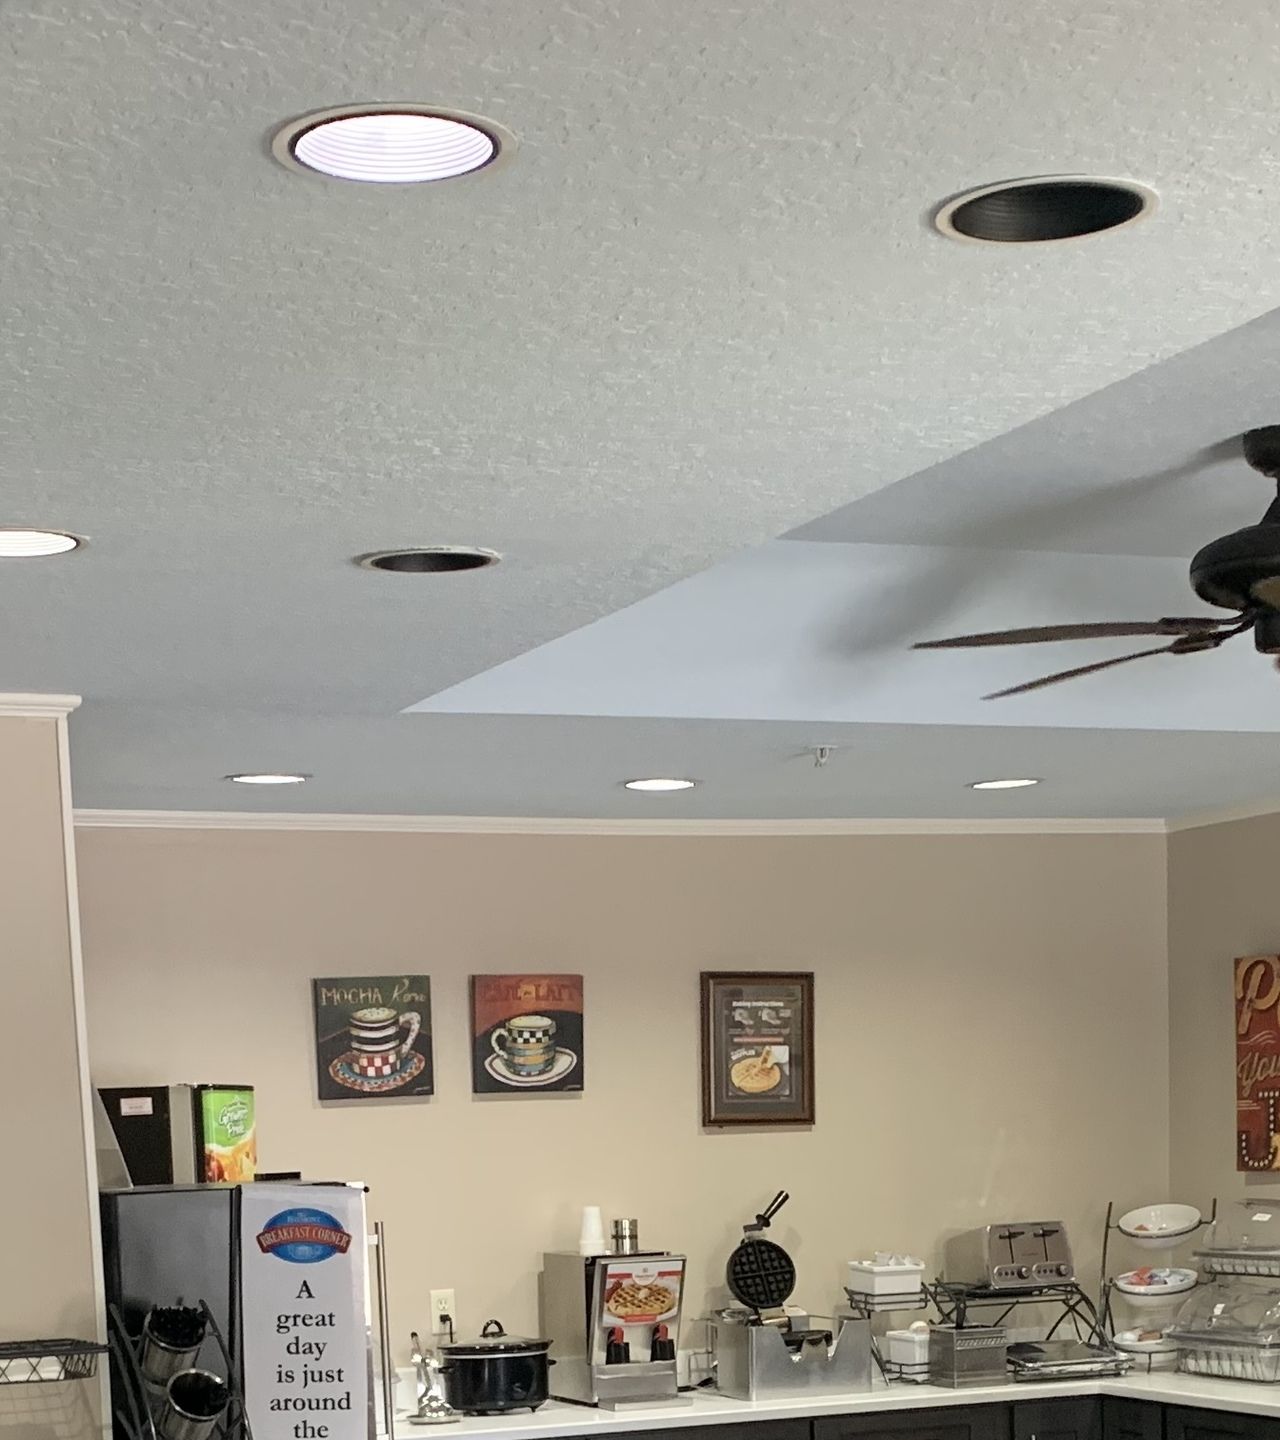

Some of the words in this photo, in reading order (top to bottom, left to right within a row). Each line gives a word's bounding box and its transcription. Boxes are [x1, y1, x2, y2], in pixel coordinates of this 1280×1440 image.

[320, 987, 382, 1006] MOCHA
[260, 1226, 310, 1248] BREAKFAST
[312, 1226, 350, 1247] CORNER
[295, 1279, 316, 1299] A
[276, 1311, 336, 1335] great
[286, 1335, 328, 1361] day
[276, 1364, 295, 1384] is
[302, 1363, 345, 1389] just
[269, 1391, 352, 1411] around
[293, 1419, 329, 1439] the
